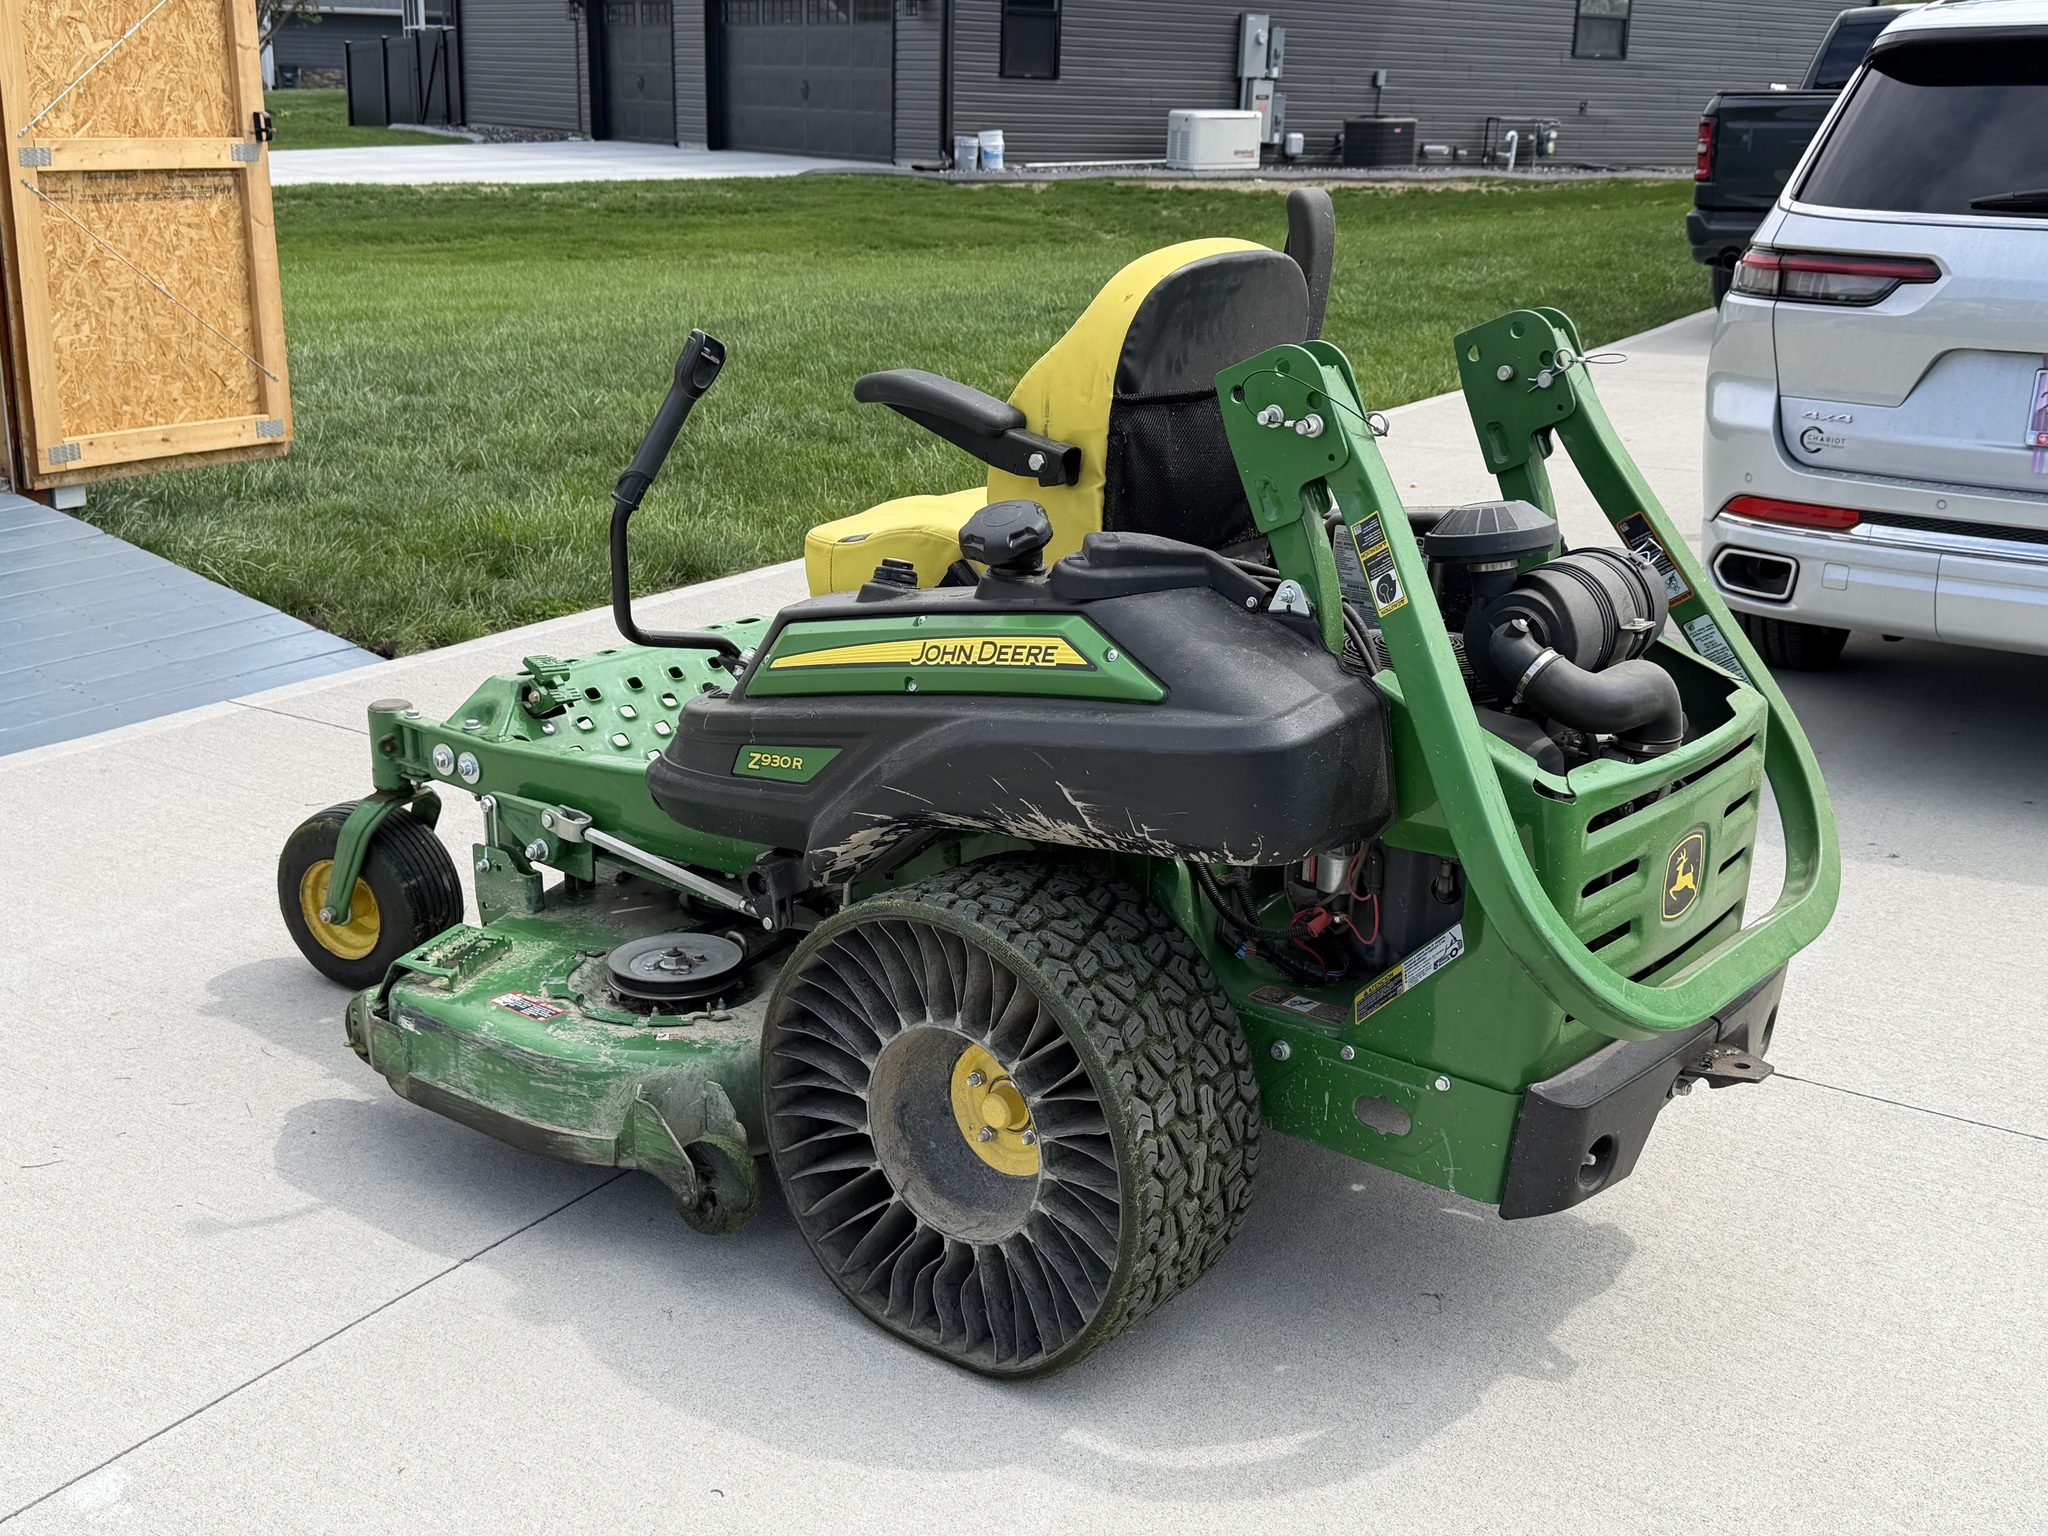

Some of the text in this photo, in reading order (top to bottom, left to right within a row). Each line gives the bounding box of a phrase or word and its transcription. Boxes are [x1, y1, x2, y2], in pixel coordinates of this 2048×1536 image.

[1801, 411, 1853, 424] 4x4
[1807, 434, 1846, 444] CHARIOT
[910, 640, 1059, 665] JOHN DEERE
